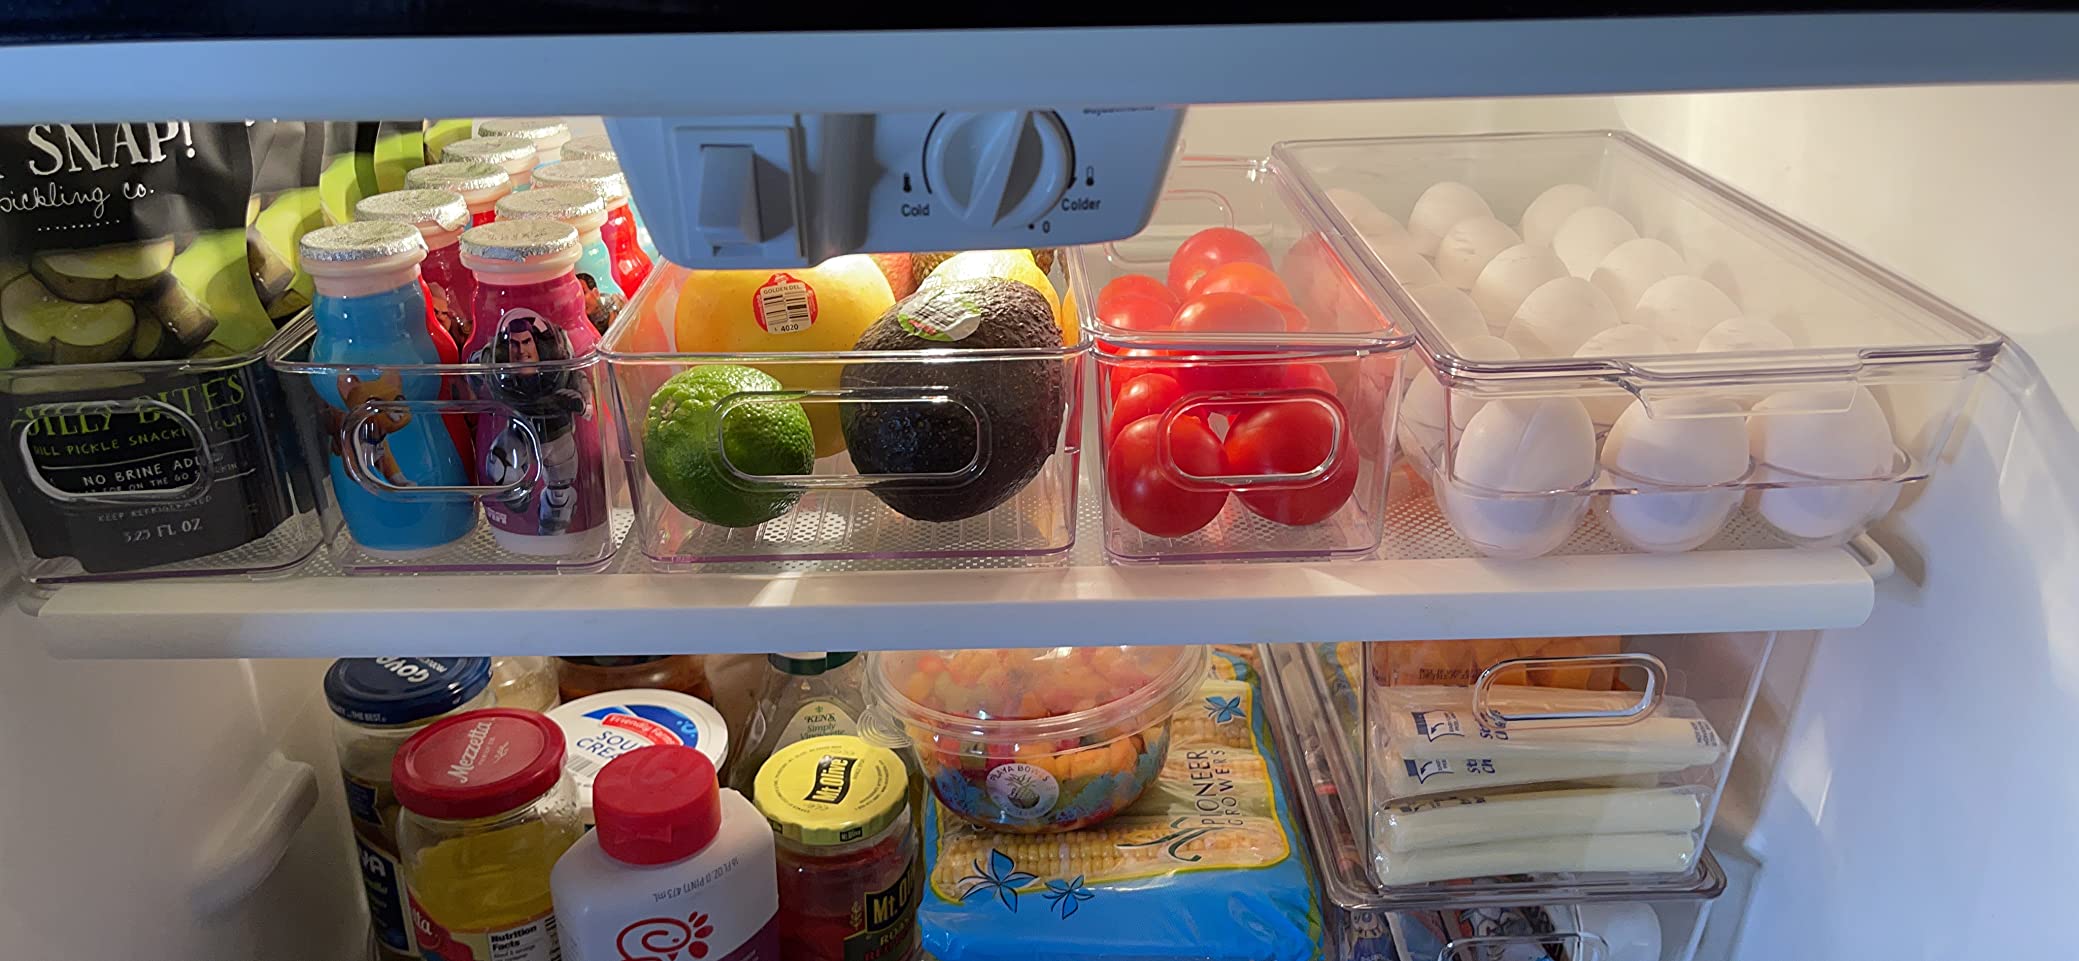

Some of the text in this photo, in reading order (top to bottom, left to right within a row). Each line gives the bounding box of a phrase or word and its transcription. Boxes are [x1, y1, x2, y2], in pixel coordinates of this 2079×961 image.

[28, 120, 196, 176] SNAP!
[901, 197, 1101, 217] Cold Colder
[1042, 220, 1051, 234] 0
[763, 285, 788, 295] GOLDEN
[781, 323, 799, 332] 4020
[67, 439, 120, 455] PICKLE
[83, 474, 106, 486] NO
[115, 463, 163, 483] BRINE
[576, 737, 615, 760] CRE
[595, 730, 638, 751] SOU
[447, 721, 493, 784] Mezzetta
[819, 757, 849, 787] Olive
[1186, 749, 1226, 825] PIONEER
[1210, 749, 1244, 826] GROWERS
[667, 887, 682, 899] 473
[873, 895, 898, 925] Mt.
[491, 925, 538, 943] Nutrition
[492, 940, 521, 951] Facts
